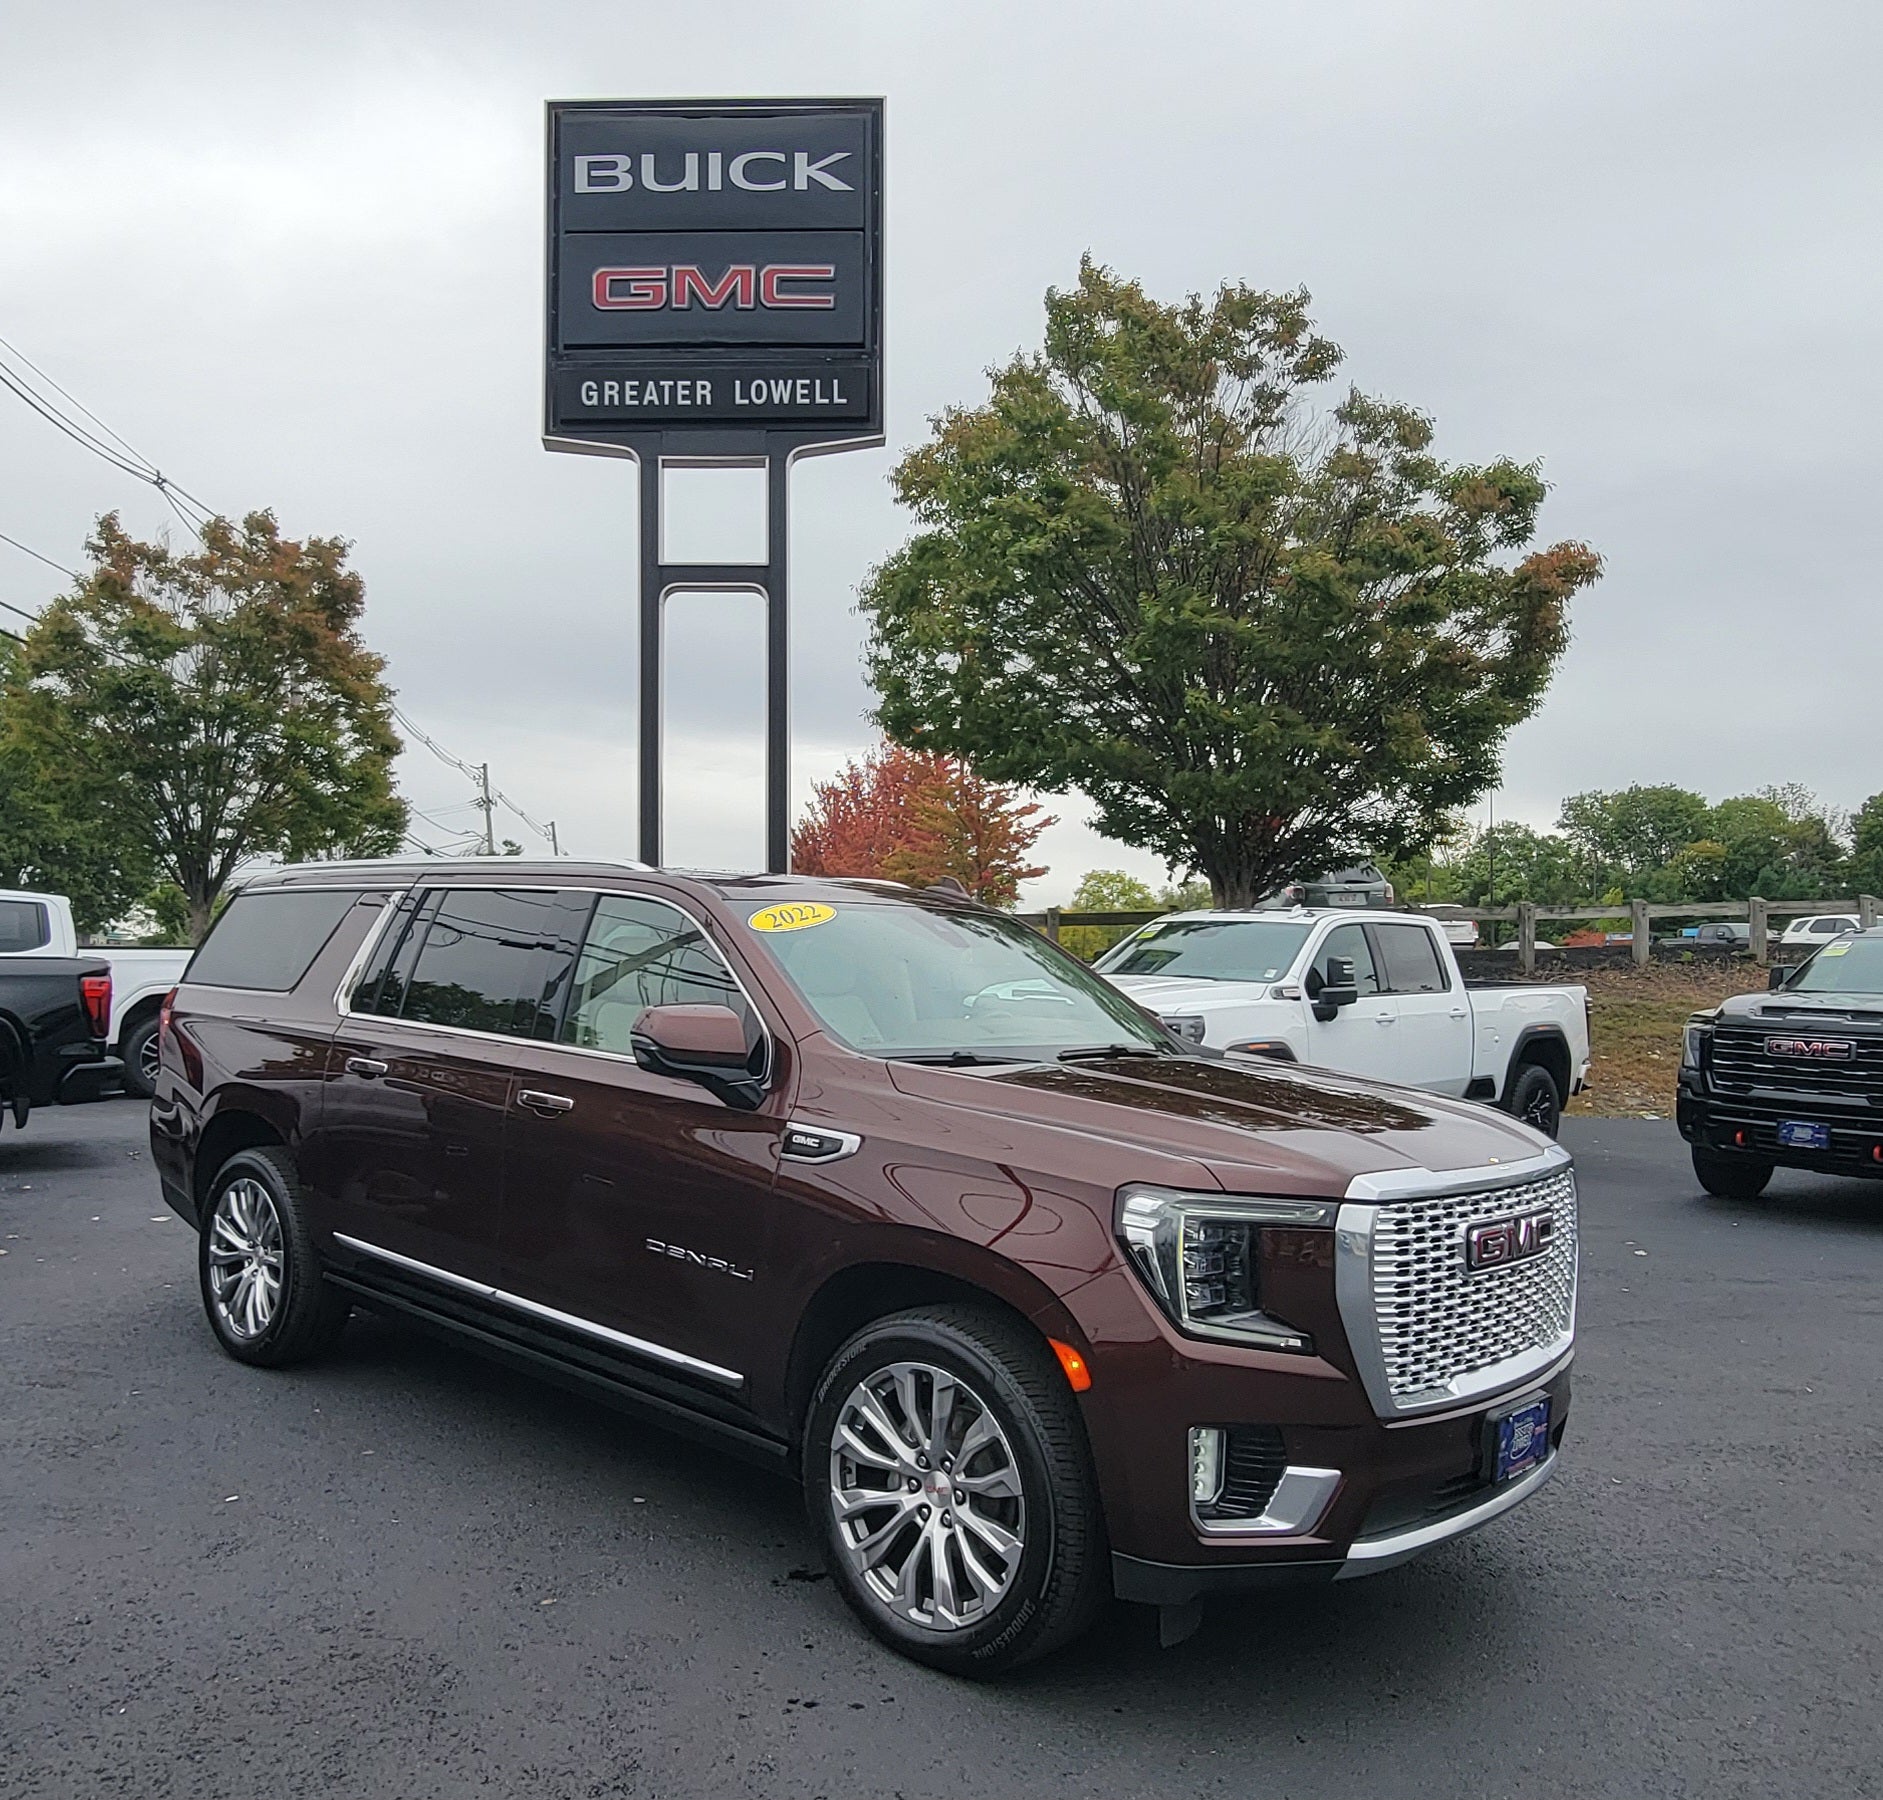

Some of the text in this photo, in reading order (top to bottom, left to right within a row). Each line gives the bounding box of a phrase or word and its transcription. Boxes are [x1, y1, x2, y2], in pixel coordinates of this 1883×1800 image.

[574, 151, 855, 194] BUICK
[592, 264, 835, 310] GMC
[581, 378, 848, 406] GREATER LOWELL
[765, 905, 821, 928] 2022
[1769, 1040, 1849, 1058] GMC
[792, 1134, 820, 1148] GMC
[1471, 1212, 1558, 1267] GMC
[645, 1238, 754, 1281] DENALI
